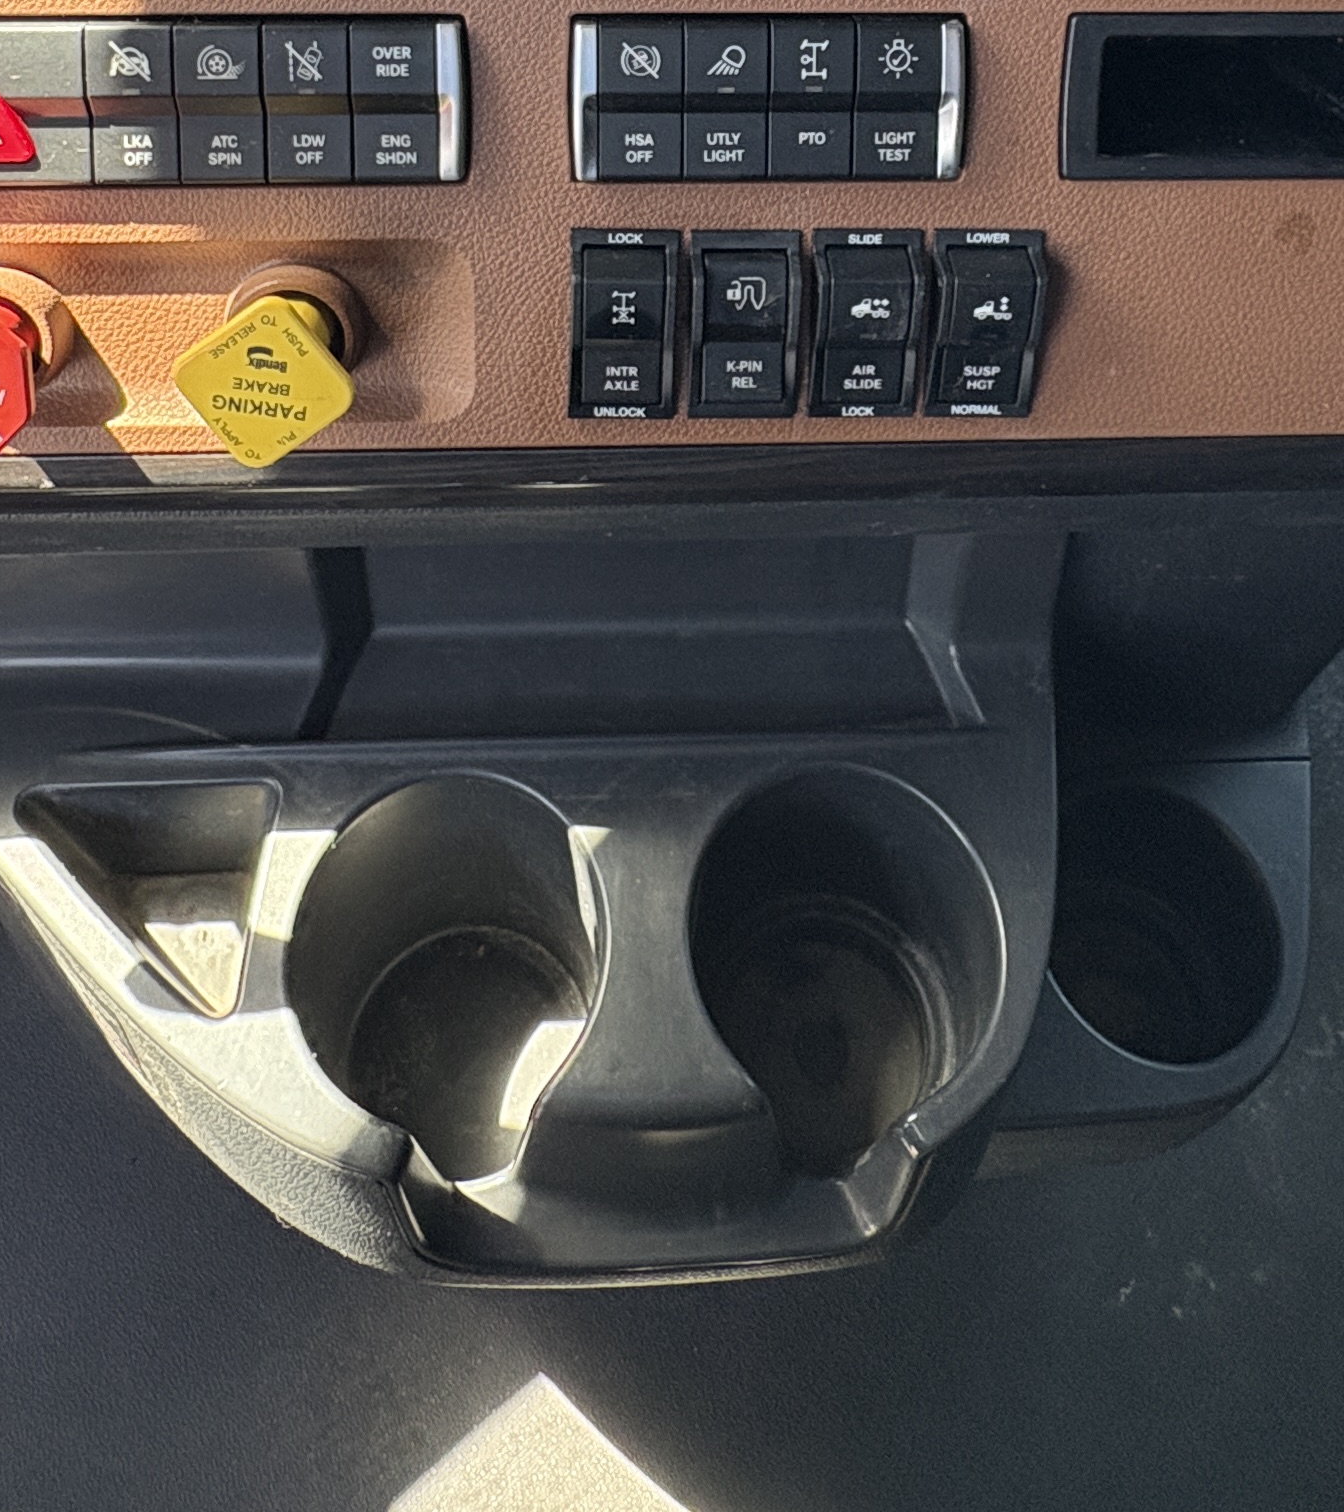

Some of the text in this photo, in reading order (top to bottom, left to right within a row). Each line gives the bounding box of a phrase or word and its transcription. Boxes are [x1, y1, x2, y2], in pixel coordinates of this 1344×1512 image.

[371, 46, 412, 61] OVER
[375, 63, 410, 78] RIDE
[122, 135, 154, 150] LKA
[210, 134, 239, 149] ATC
[292, 134, 326, 149] LDW
[380, 134, 412, 149] ENG
[624, 133, 655, 148] HSA
[706, 132, 742, 146] UTLY
[798, 131, 827, 146] PTO
[874, 131, 916, 146] LIGHT
[123, 152, 154, 167] OFF
[207, 151, 243, 166] SPIN
[294, 150, 325, 165] OFF
[375, 150, 418, 166] SHDN
[625, 150, 654, 164] OFF
[703, 148, 746, 163] LIGHT
[877, 147, 912, 163] TEST
[607, 232, 644, 245] LOCK
[847, 233, 884, 246] SLIDE
[966, 232, 1010, 245] LOWER
[207, 314, 310, 360] PUSH TO RELEASE
[247, 356, 289, 374] Bendix
[605, 365, 639, 378] INTR
[725, 360, 763, 373] K-PIN
[852, 364, 876, 376] AIR
[963, 365, 1001, 377] SUSP
[232, 375, 291, 397] BRAKE
[603, 379, 640, 392] AXLE
[731, 376, 757, 389] REL
[843, 378, 883, 390] SLIDE
[966, 378, 995, 390] HGT
[211, 393, 309, 422] PARKING
[593, 406, 647, 418] UNLOCK
[841, 405, 875, 417] LOCK
[950, 404, 1002, 416] NORMAL
[211, 416, 244, 447] APPLY
[244, 448, 262, 461] TO
